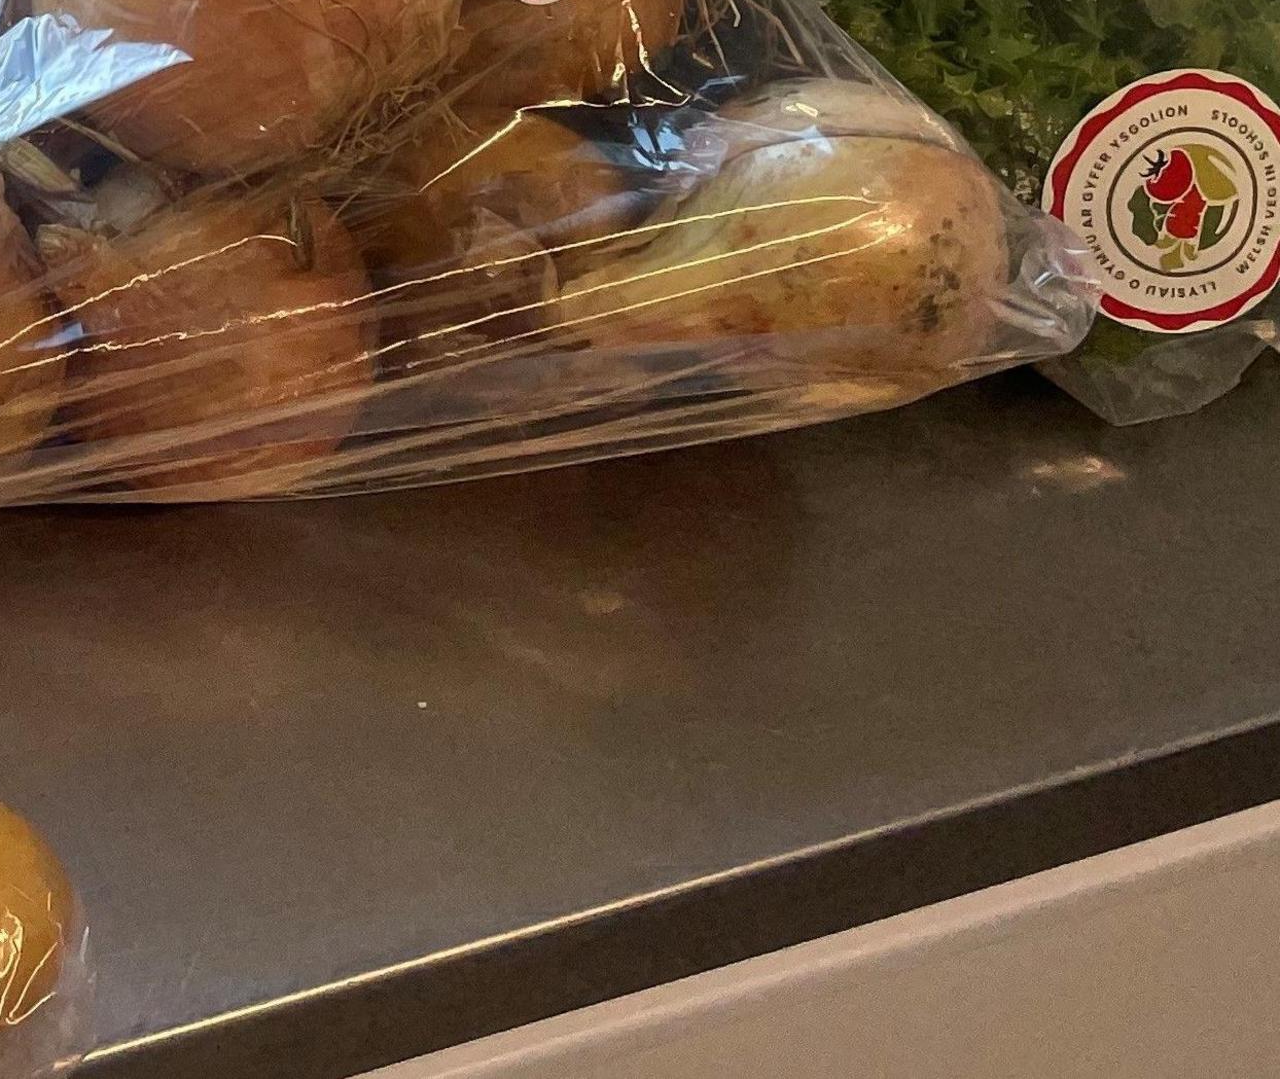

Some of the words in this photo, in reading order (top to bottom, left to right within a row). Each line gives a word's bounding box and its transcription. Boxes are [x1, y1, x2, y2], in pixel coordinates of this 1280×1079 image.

[1111, 104, 1189, 151] YSGOLION
[1211, 109, 1270, 163] SCHOOLS
[1083, 153, 1111, 201] GYFER
[1081, 208, 1093, 227] AR
[1265, 186, 1277, 222] VEG
[1086, 235, 1124, 280] GYMRU
[1236, 226, 1273, 275] WELSH
[1129, 279, 1141, 289] O
[1145, 281, 1216, 298] LLYSIAU
